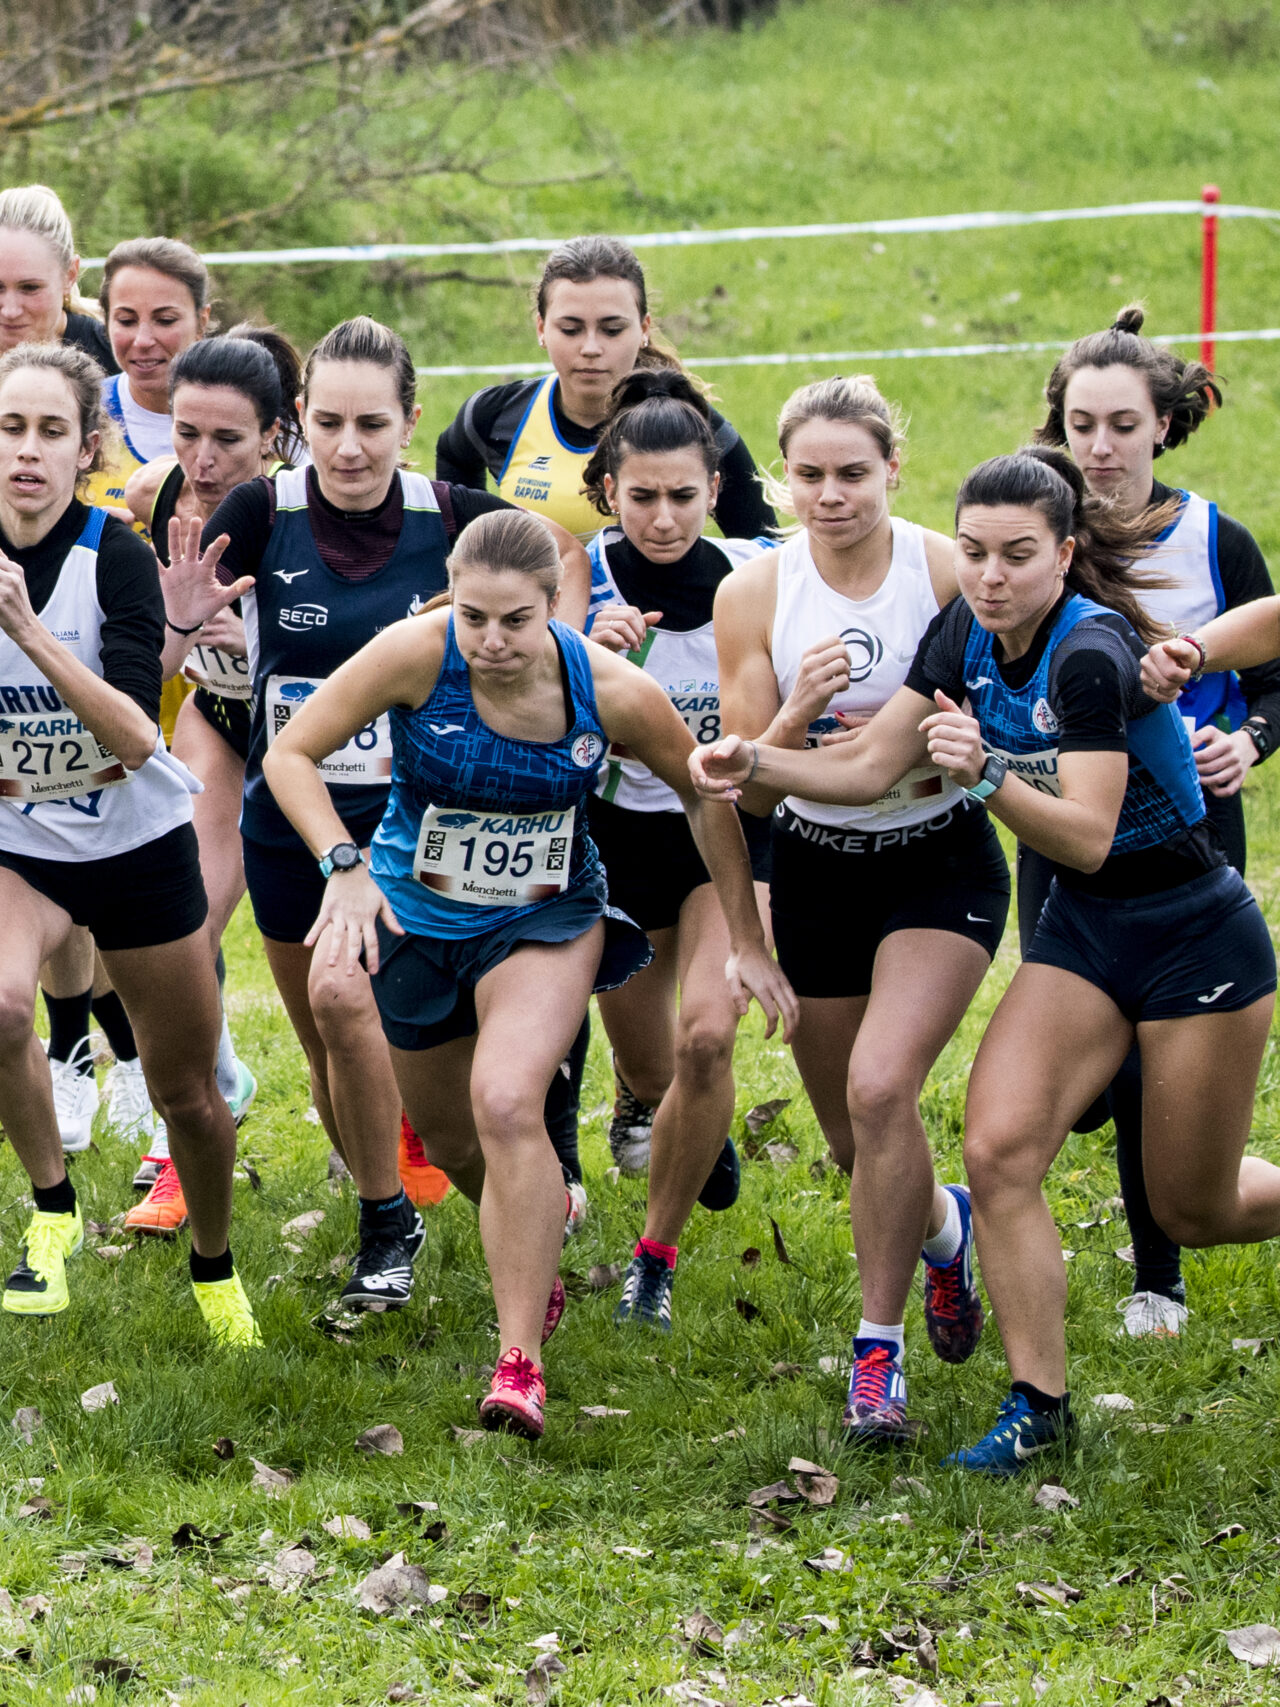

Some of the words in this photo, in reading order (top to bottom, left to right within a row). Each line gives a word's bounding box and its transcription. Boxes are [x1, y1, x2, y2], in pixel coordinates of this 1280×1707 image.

[514, 485, 549, 501] RAPIDA
[279, 608, 328, 626] SECO
[20, 718, 89, 738] KARH
[12, 739, 90, 775] 272
[1003, 756, 1058, 776] ARHU
[30, 779, 84, 794] Menchetti
[479, 813, 565, 837] KARHU
[789, 816, 867, 853] NIKE
[874, 809, 953, 852] PRO
[459, 836, 535, 878] 195
[462, 880, 517, 897] Menchetti
